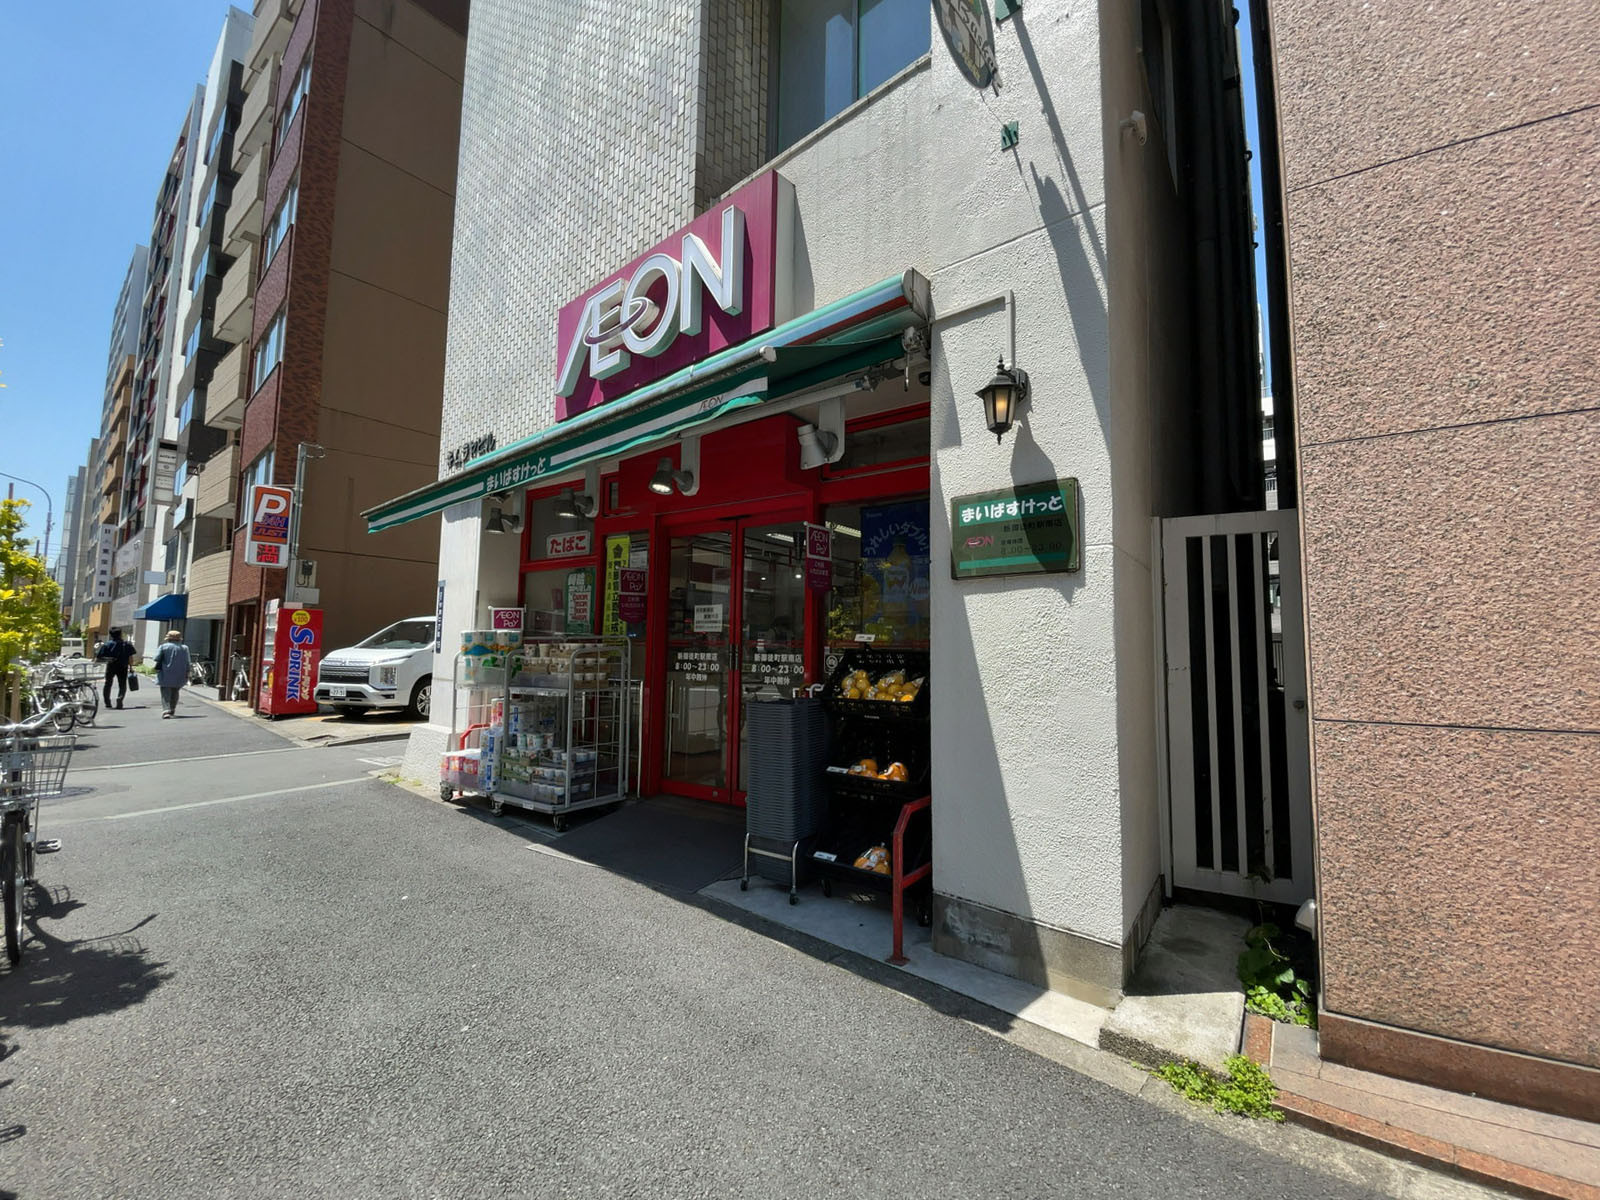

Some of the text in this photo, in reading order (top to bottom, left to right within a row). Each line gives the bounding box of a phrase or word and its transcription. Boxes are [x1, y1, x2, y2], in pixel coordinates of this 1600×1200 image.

[486, 457, 546, 491] まいばすけっと
[254, 493, 287, 522] P
[961, 496, 1063, 522] まいばすけっと
[256, 544, 280, 564] 満
[550, 535, 587, 554] たばこ
